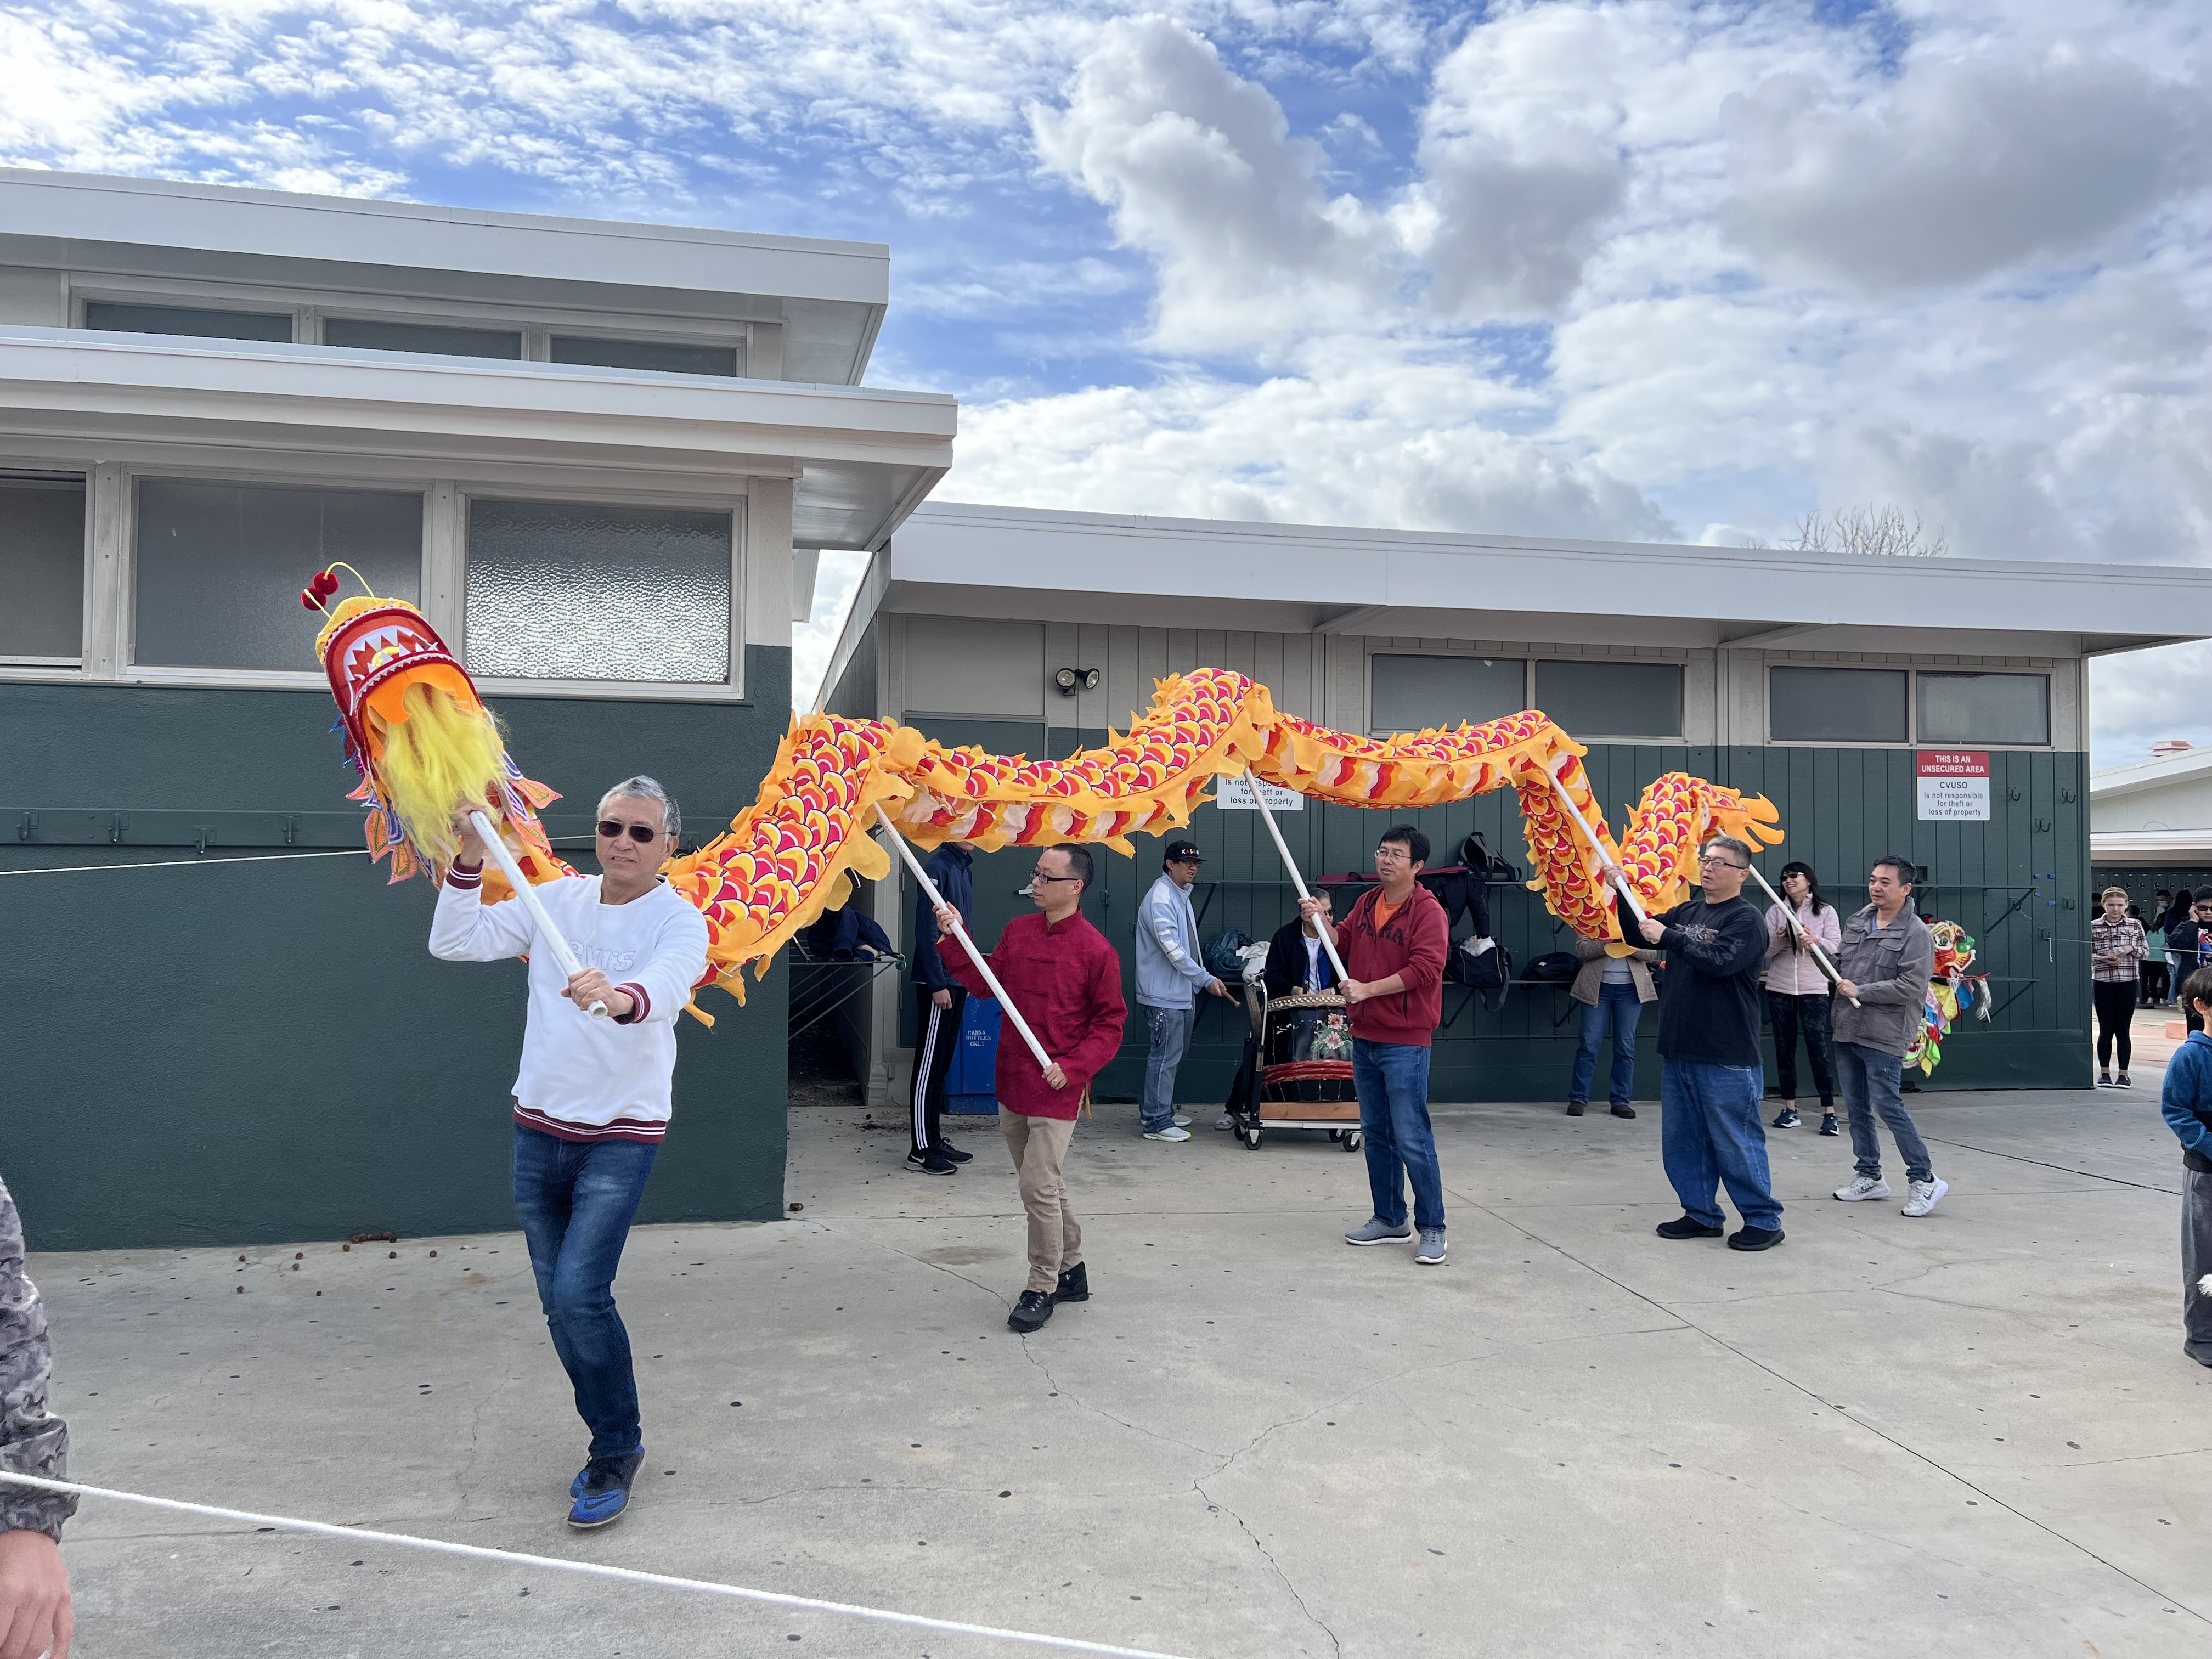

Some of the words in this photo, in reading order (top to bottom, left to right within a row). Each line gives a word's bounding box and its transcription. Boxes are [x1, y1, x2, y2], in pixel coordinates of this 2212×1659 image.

[1935, 755, 1951, 763] THIS
[1921, 765, 1964, 773] UNSECURED
[1945, 792, 1983, 800] responsible
[1265, 798, 1293, 807] roperty
[1954, 809, 1981, 817] property
